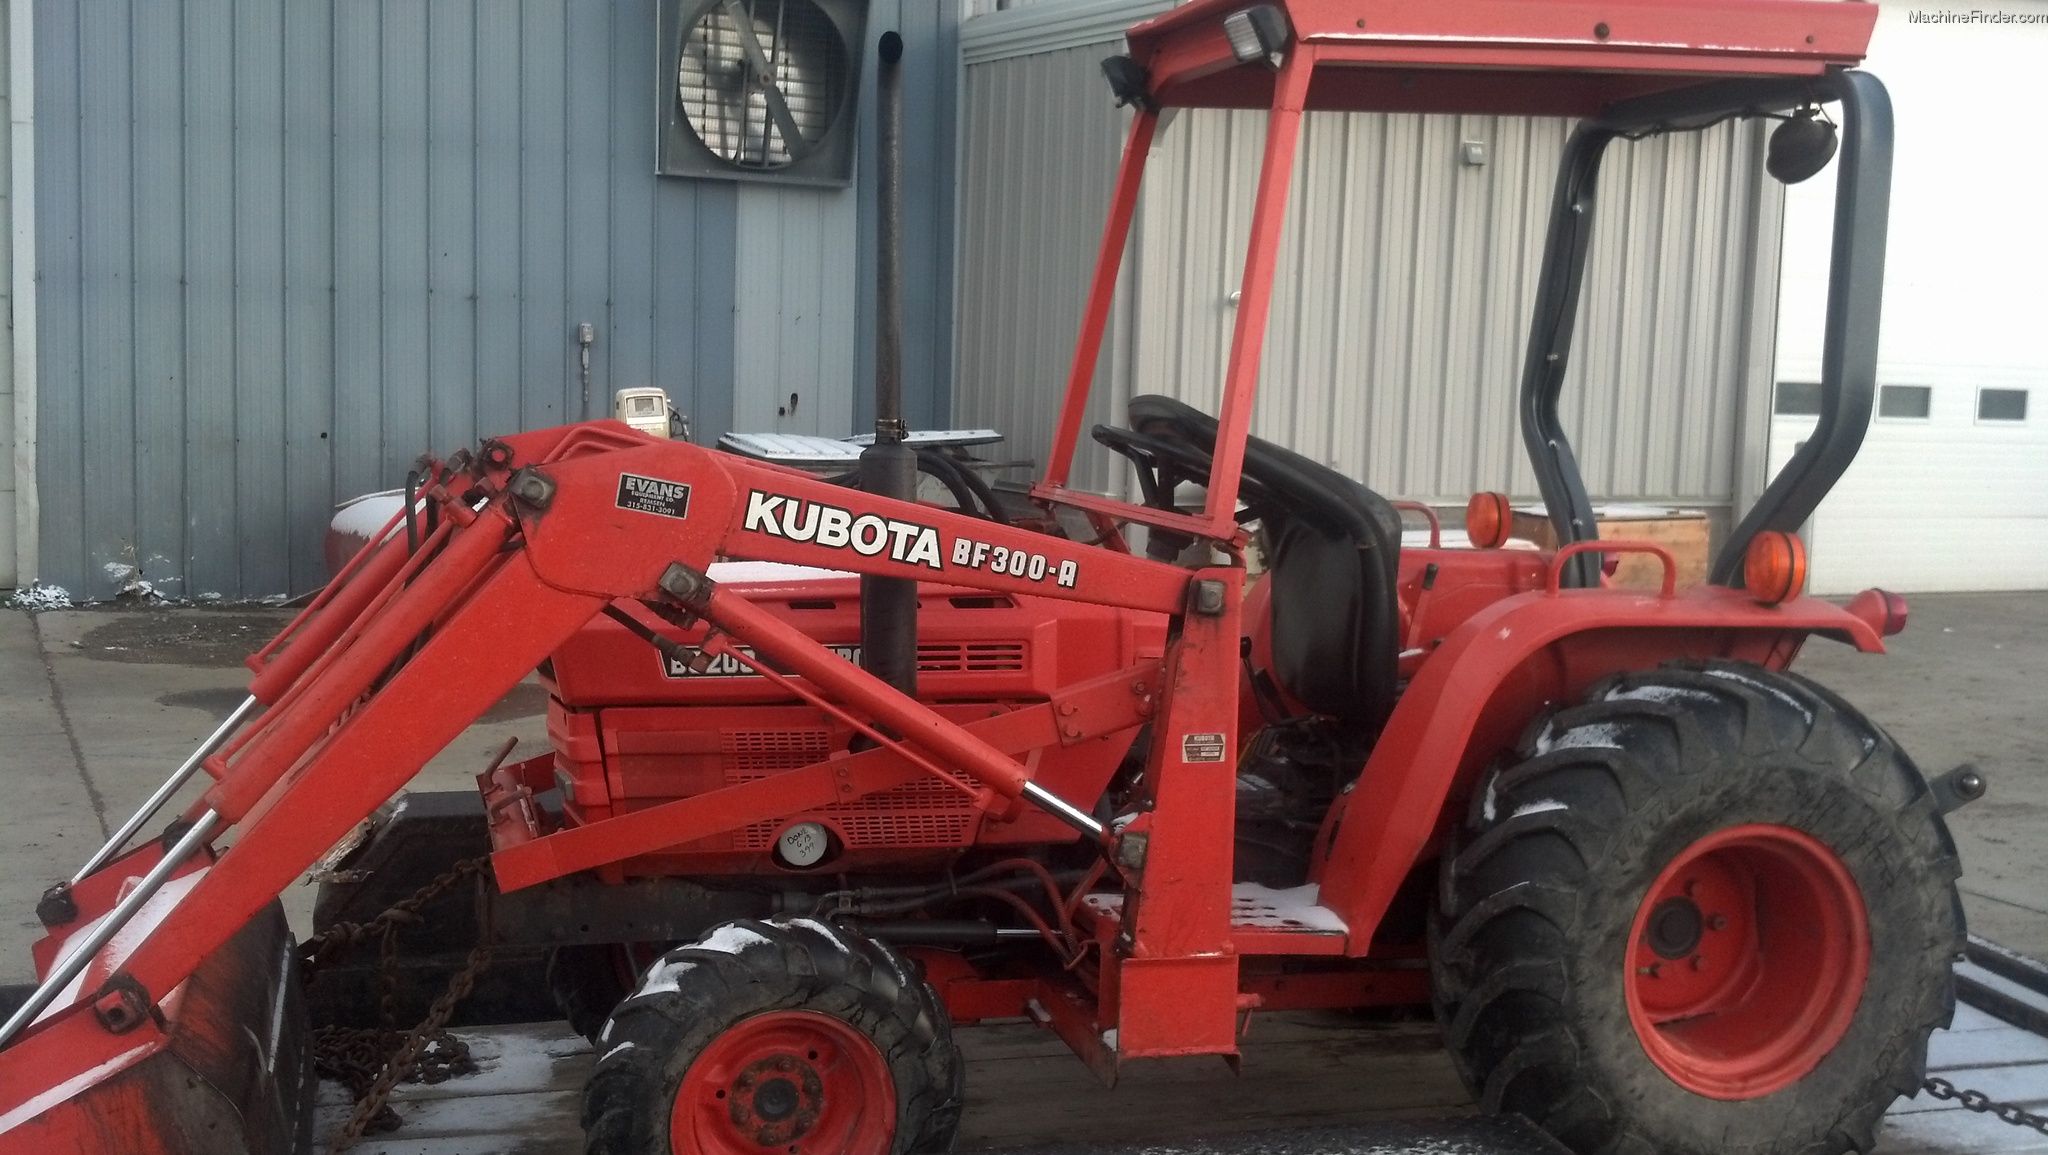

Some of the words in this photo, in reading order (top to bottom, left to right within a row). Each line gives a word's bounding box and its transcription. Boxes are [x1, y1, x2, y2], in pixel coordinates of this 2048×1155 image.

[625, 477, 685, 499] EVANS
[639, 497, 666, 508] REMSEN
[743, 490, 943, 570] KUBOTA
[952, 537, 1079, 588] BF300-A
[787, 827, 809, 845] DONE
